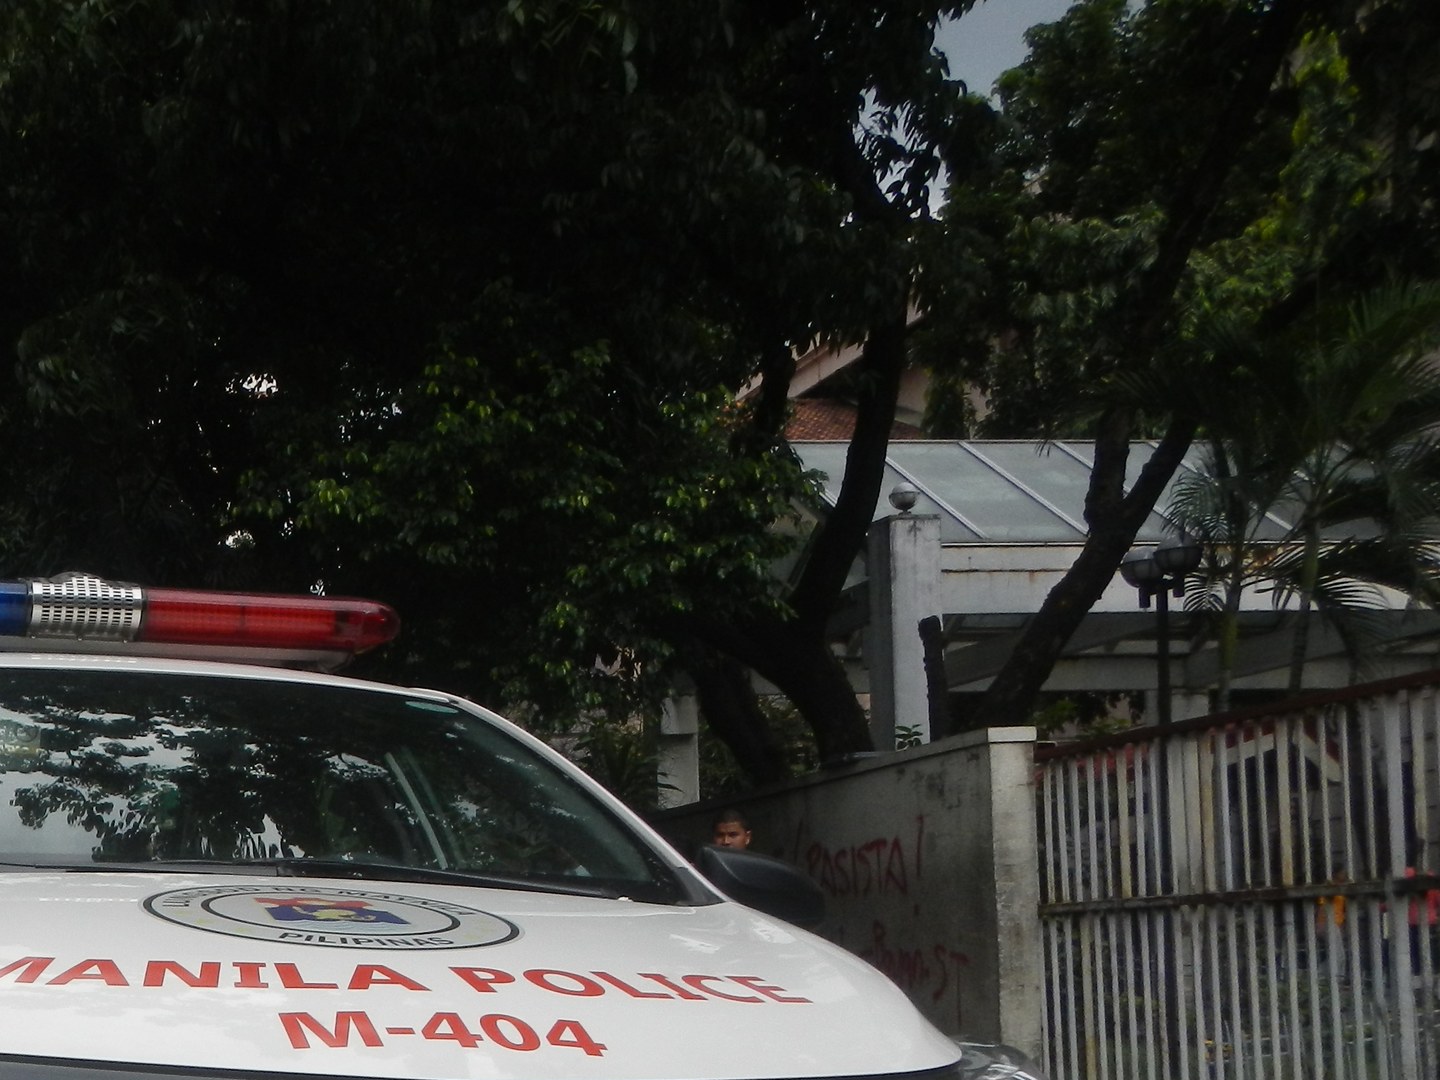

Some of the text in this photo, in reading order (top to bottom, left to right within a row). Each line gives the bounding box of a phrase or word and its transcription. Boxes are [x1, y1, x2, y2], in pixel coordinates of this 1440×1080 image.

[277, 931, 455, 946] PILIPINAS
[446, 966, 814, 1005] POLICE
[278, 1010, 609, 1058] M-404
